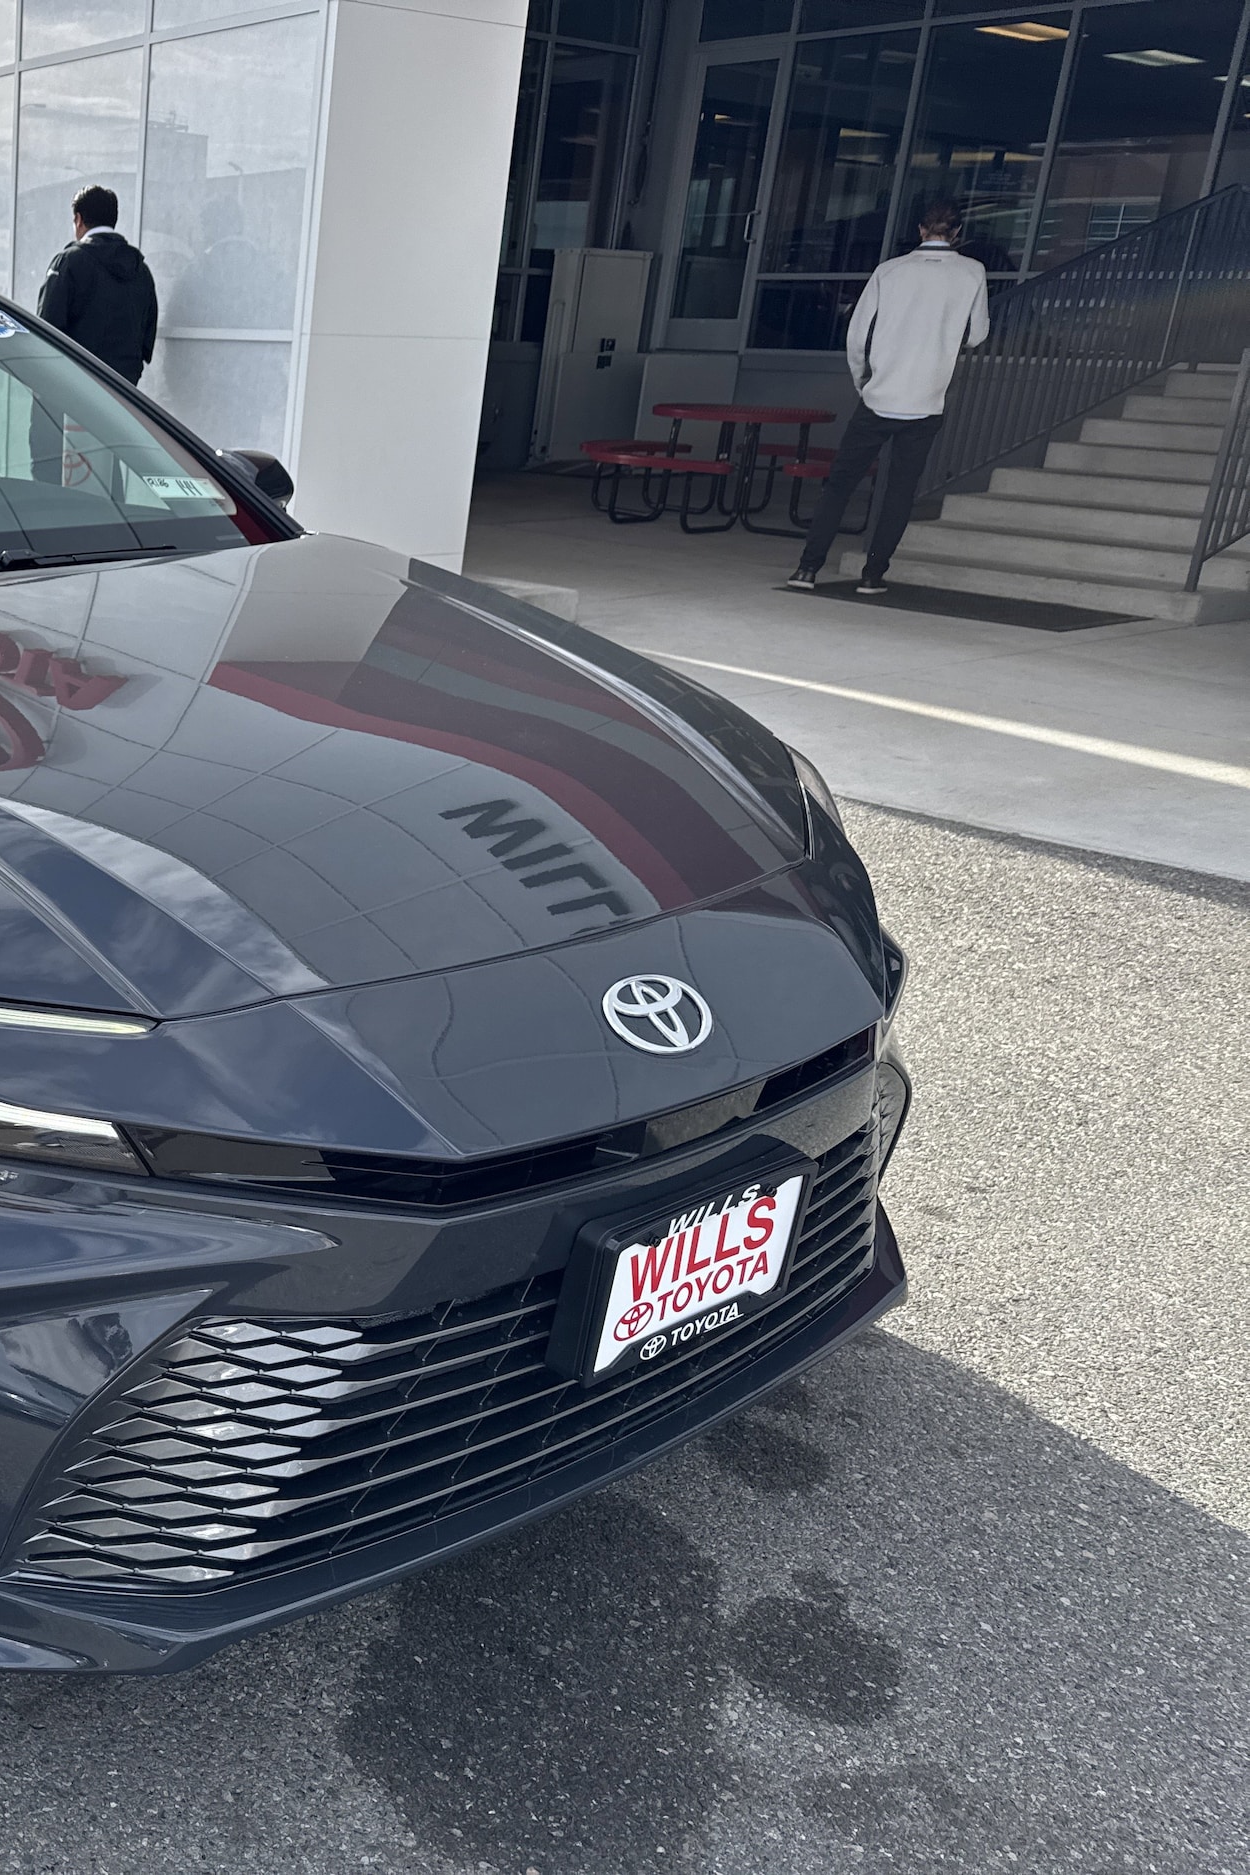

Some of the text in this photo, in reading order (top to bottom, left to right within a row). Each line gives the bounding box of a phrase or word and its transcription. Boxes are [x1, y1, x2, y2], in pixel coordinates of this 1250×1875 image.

[668, 1182, 762, 1236] WILLS
[630, 1195, 777, 1303] WILLS
[657, 1250, 769, 1321] TOYOTA
[670, 1301, 740, 1346] TOYOTA
